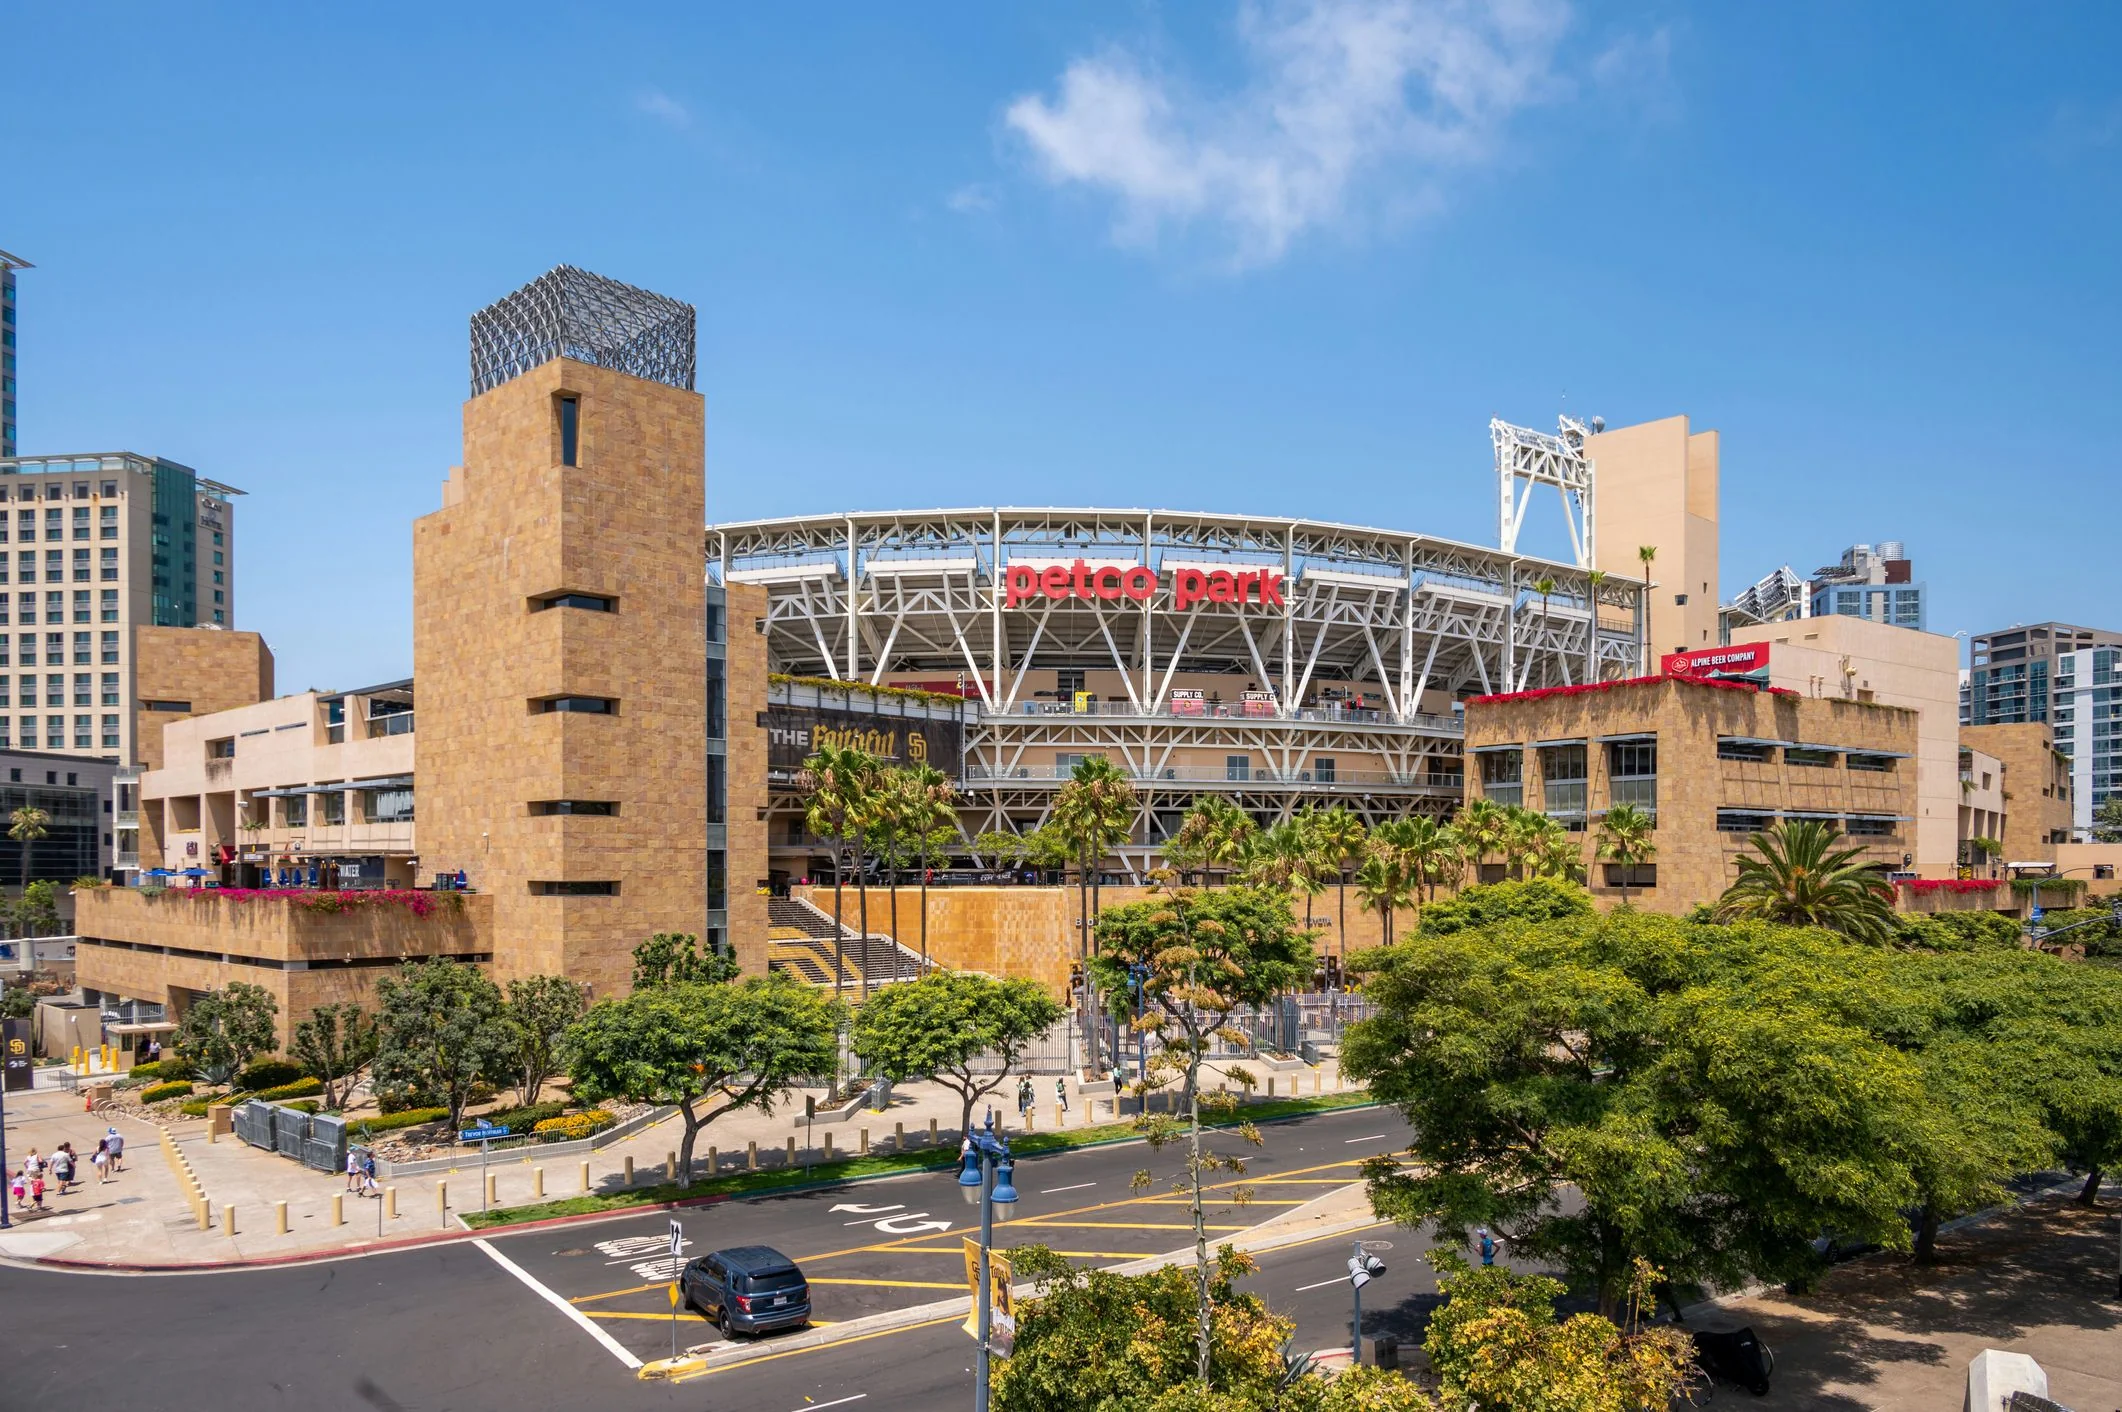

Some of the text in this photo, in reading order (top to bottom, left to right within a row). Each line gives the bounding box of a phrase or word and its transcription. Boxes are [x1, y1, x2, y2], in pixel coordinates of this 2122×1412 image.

[1006, 559, 1285, 611] petco park
[1691, 656, 1711, 668] ALPINE
[1711, 655, 1727, 665] BEER
[1727, 651, 1755, 663] COMPANY
[1173, 690, 1193, 699] SUPPLY
[1246, 693, 1267, 701] SUPPLY
[770, 728, 808, 747] THE
[812, 723, 895, 758] Faithful
